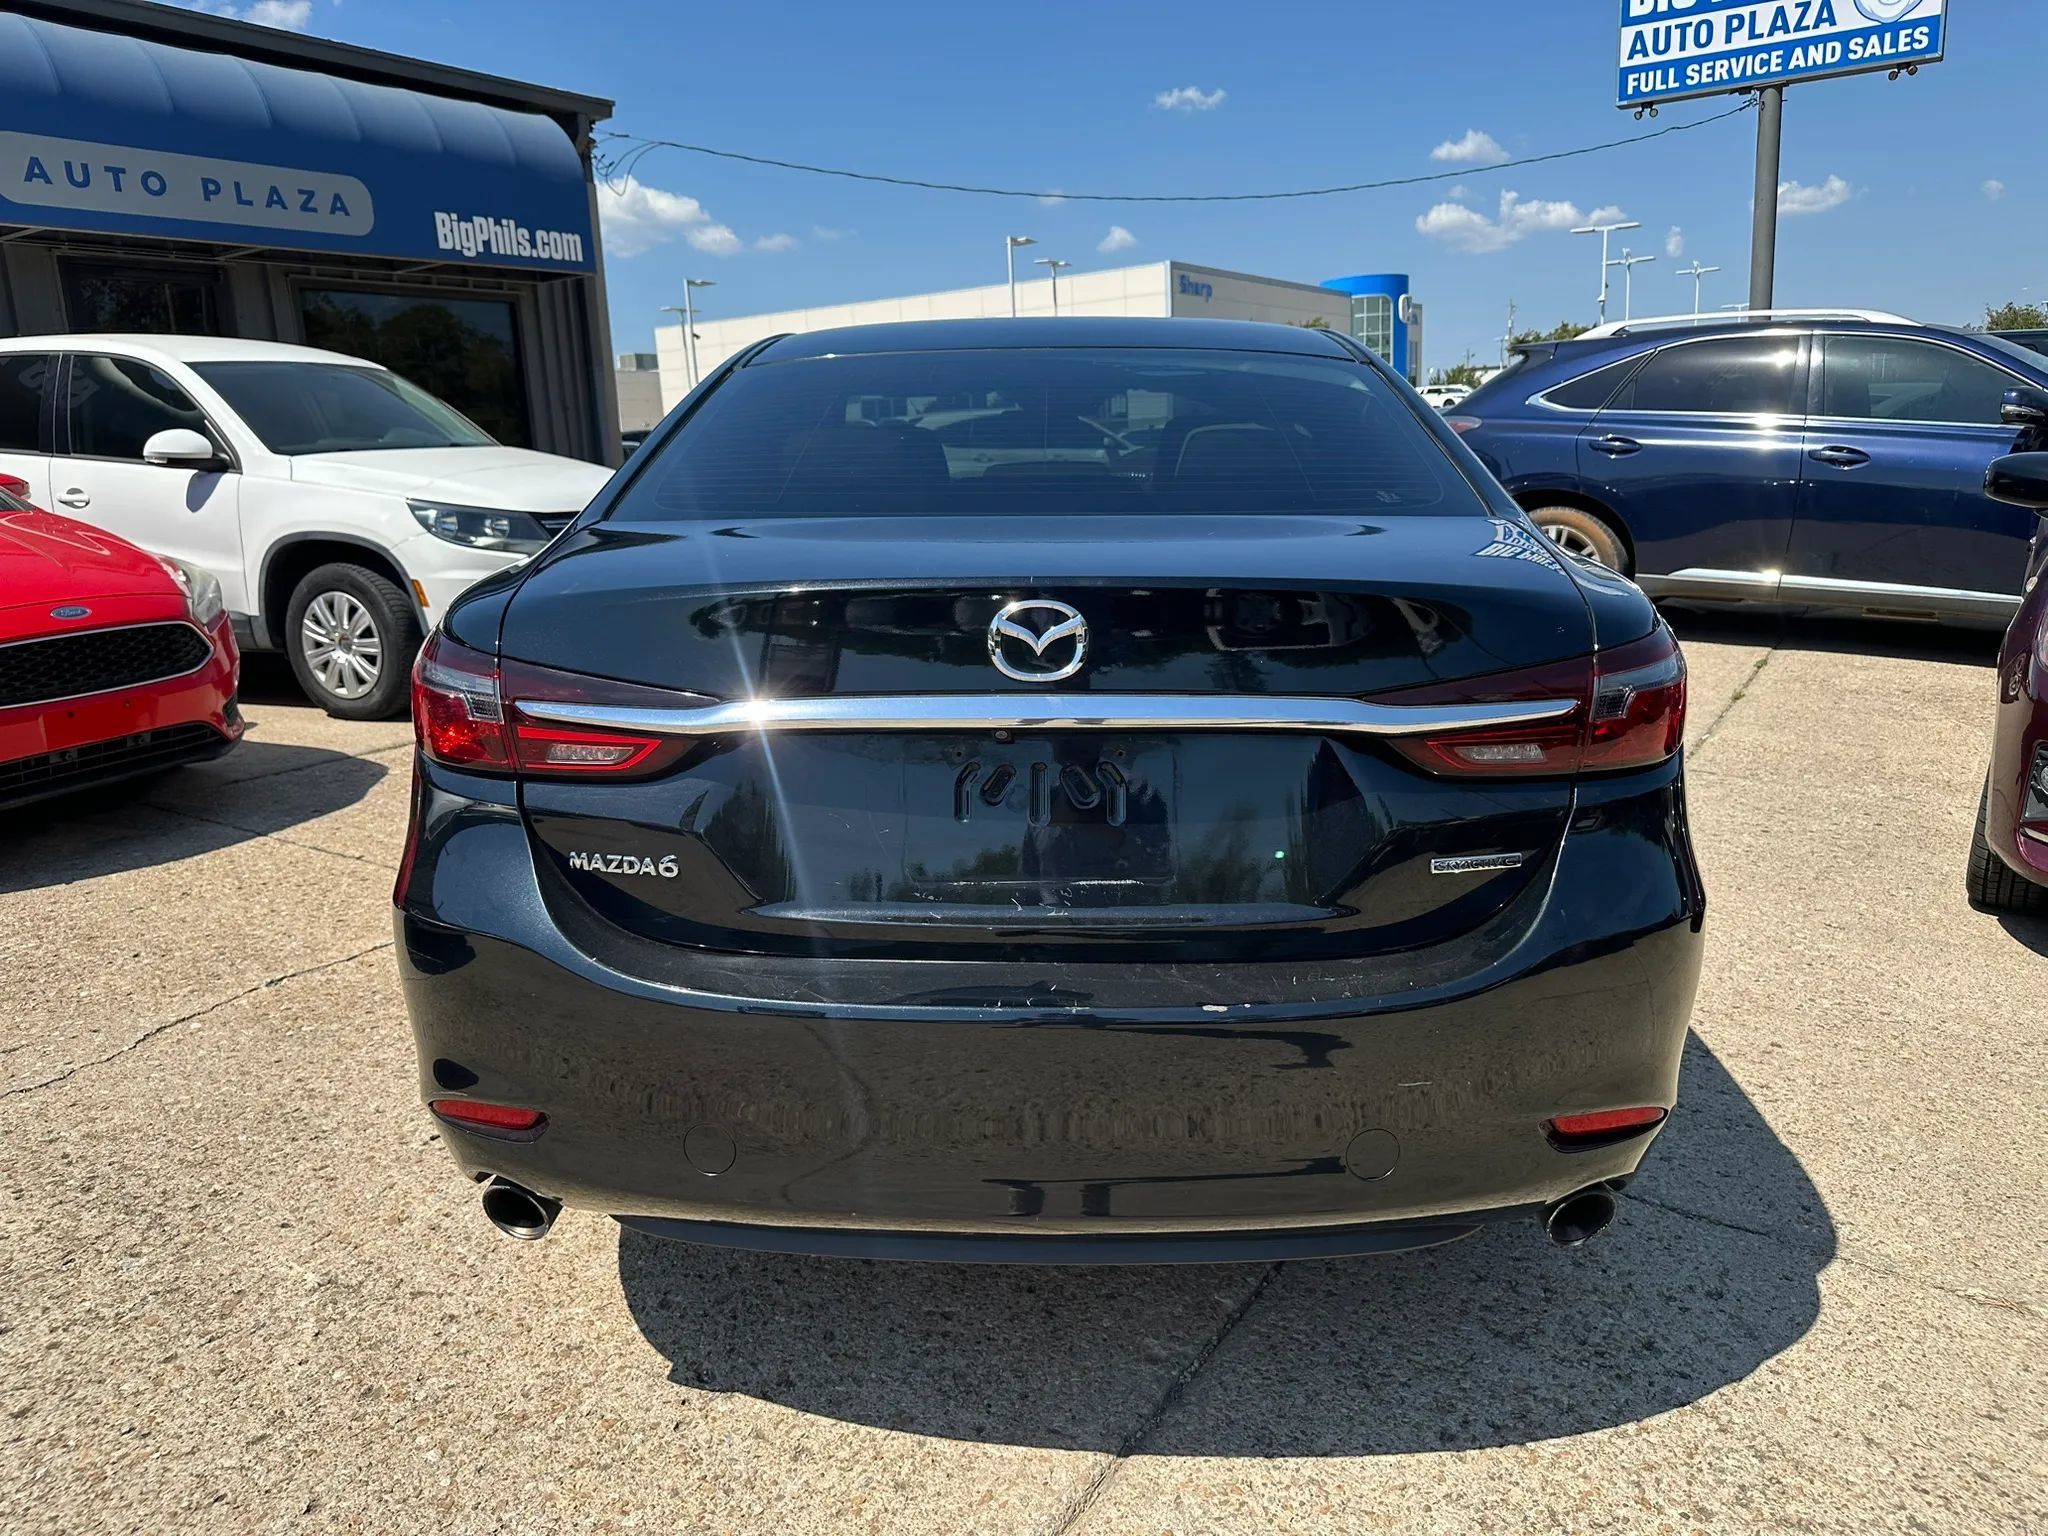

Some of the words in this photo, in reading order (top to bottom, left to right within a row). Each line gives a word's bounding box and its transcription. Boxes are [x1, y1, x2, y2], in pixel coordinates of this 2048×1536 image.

[1627, 20, 1714, 60] AUTO
[1724, 0, 1837, 44] PLAZA
[1627, 67, 1680, 95] FULL
[1685, 50, 1783, 86] SERVICE
[1788, 41, 1842, 70] AND
[1848, 26, 1930, 60] SALES
[24, 156, 167, 196] AUTO
[201, 177, 350, 216] PLAZA
[434, 212, 584, 262] BigPhils.com
[569, 851, 680, 878] MAZDA6
